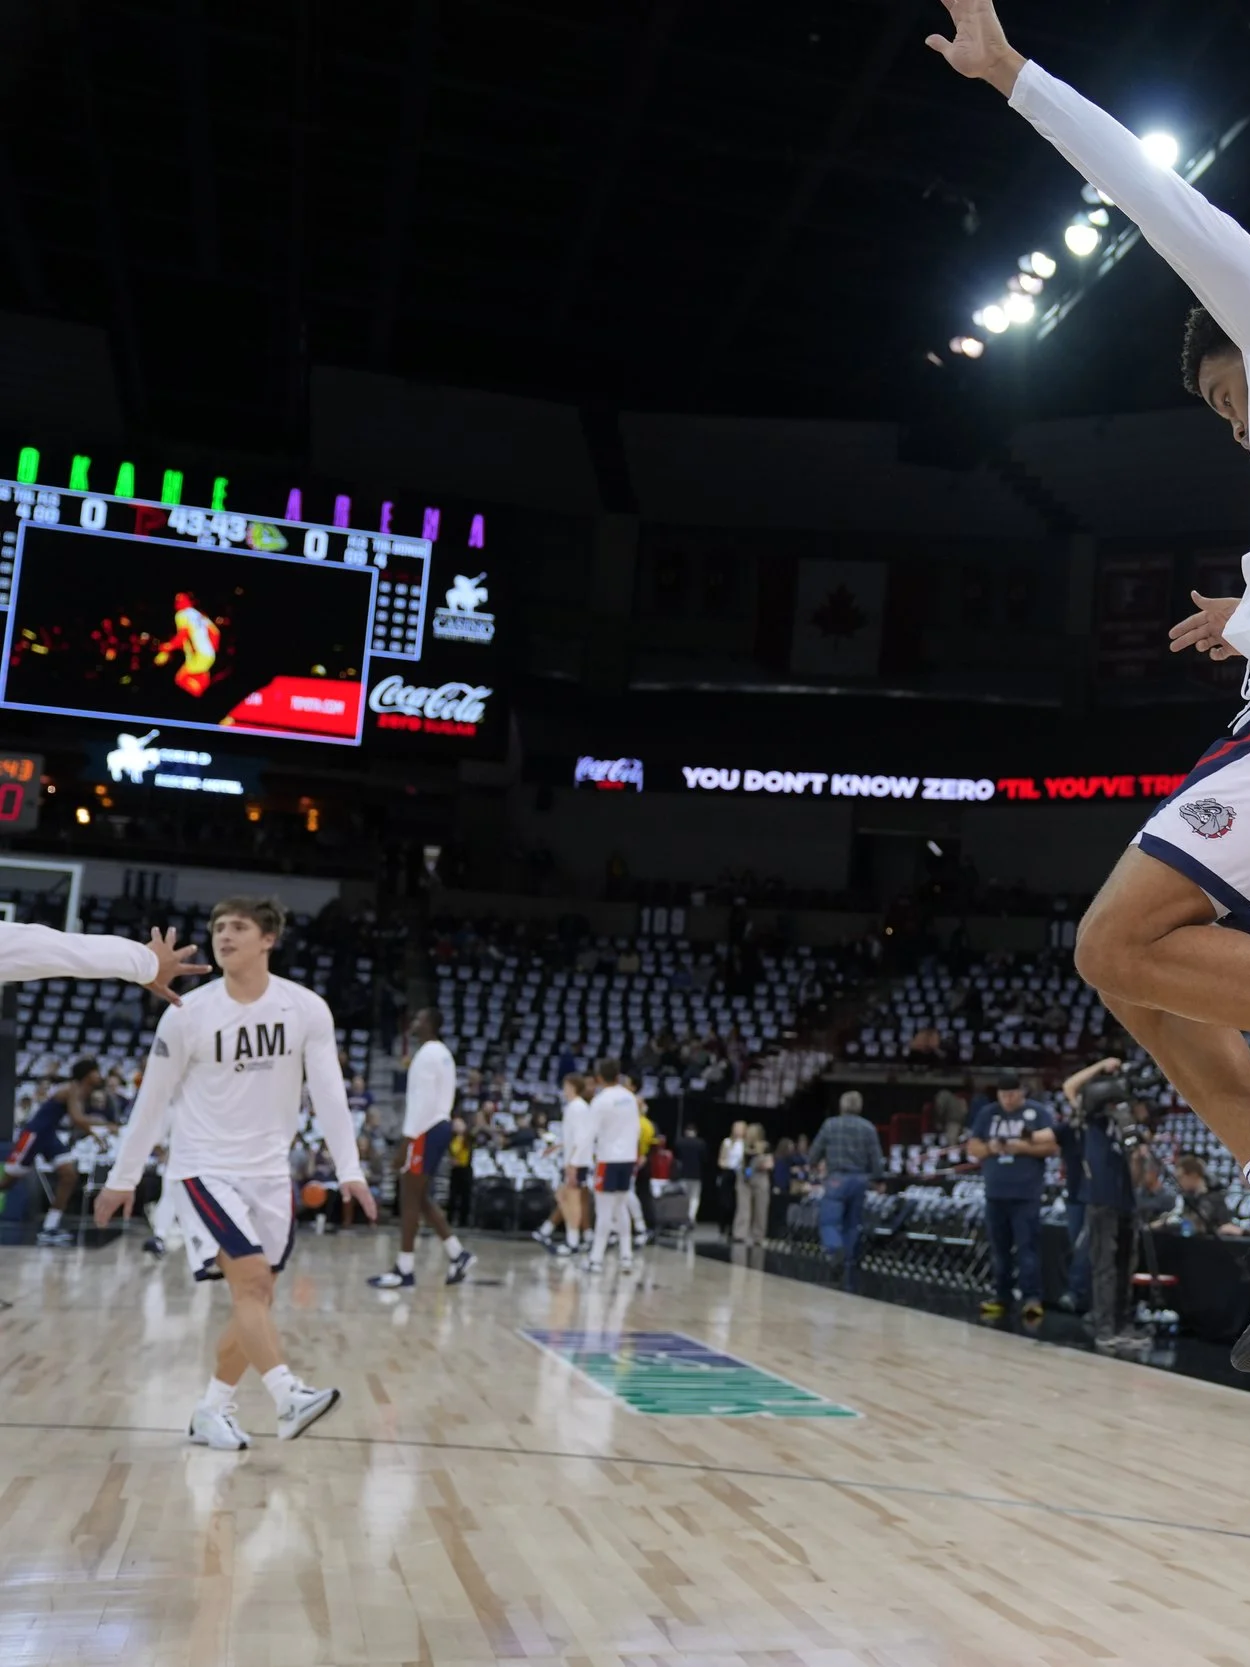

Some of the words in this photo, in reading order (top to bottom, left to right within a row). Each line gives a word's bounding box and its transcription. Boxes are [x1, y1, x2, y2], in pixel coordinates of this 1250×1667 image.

[80, 498, 108, 530] 0
[304, 528, 328, 561] 0
[369, 674, 493, 723] Coca-Cola
[682, 766, 740, 790] YOU
[743, 769, 828, 795] DON'T
[831, 774, 918, 799] KNOW
[921, 778, 995, 800] ZERO
[1044, 777, 1134, 798] YOU'VE
[1139, 774, 1187, 797] TRI
[215, 1030, 222, 1063] I
